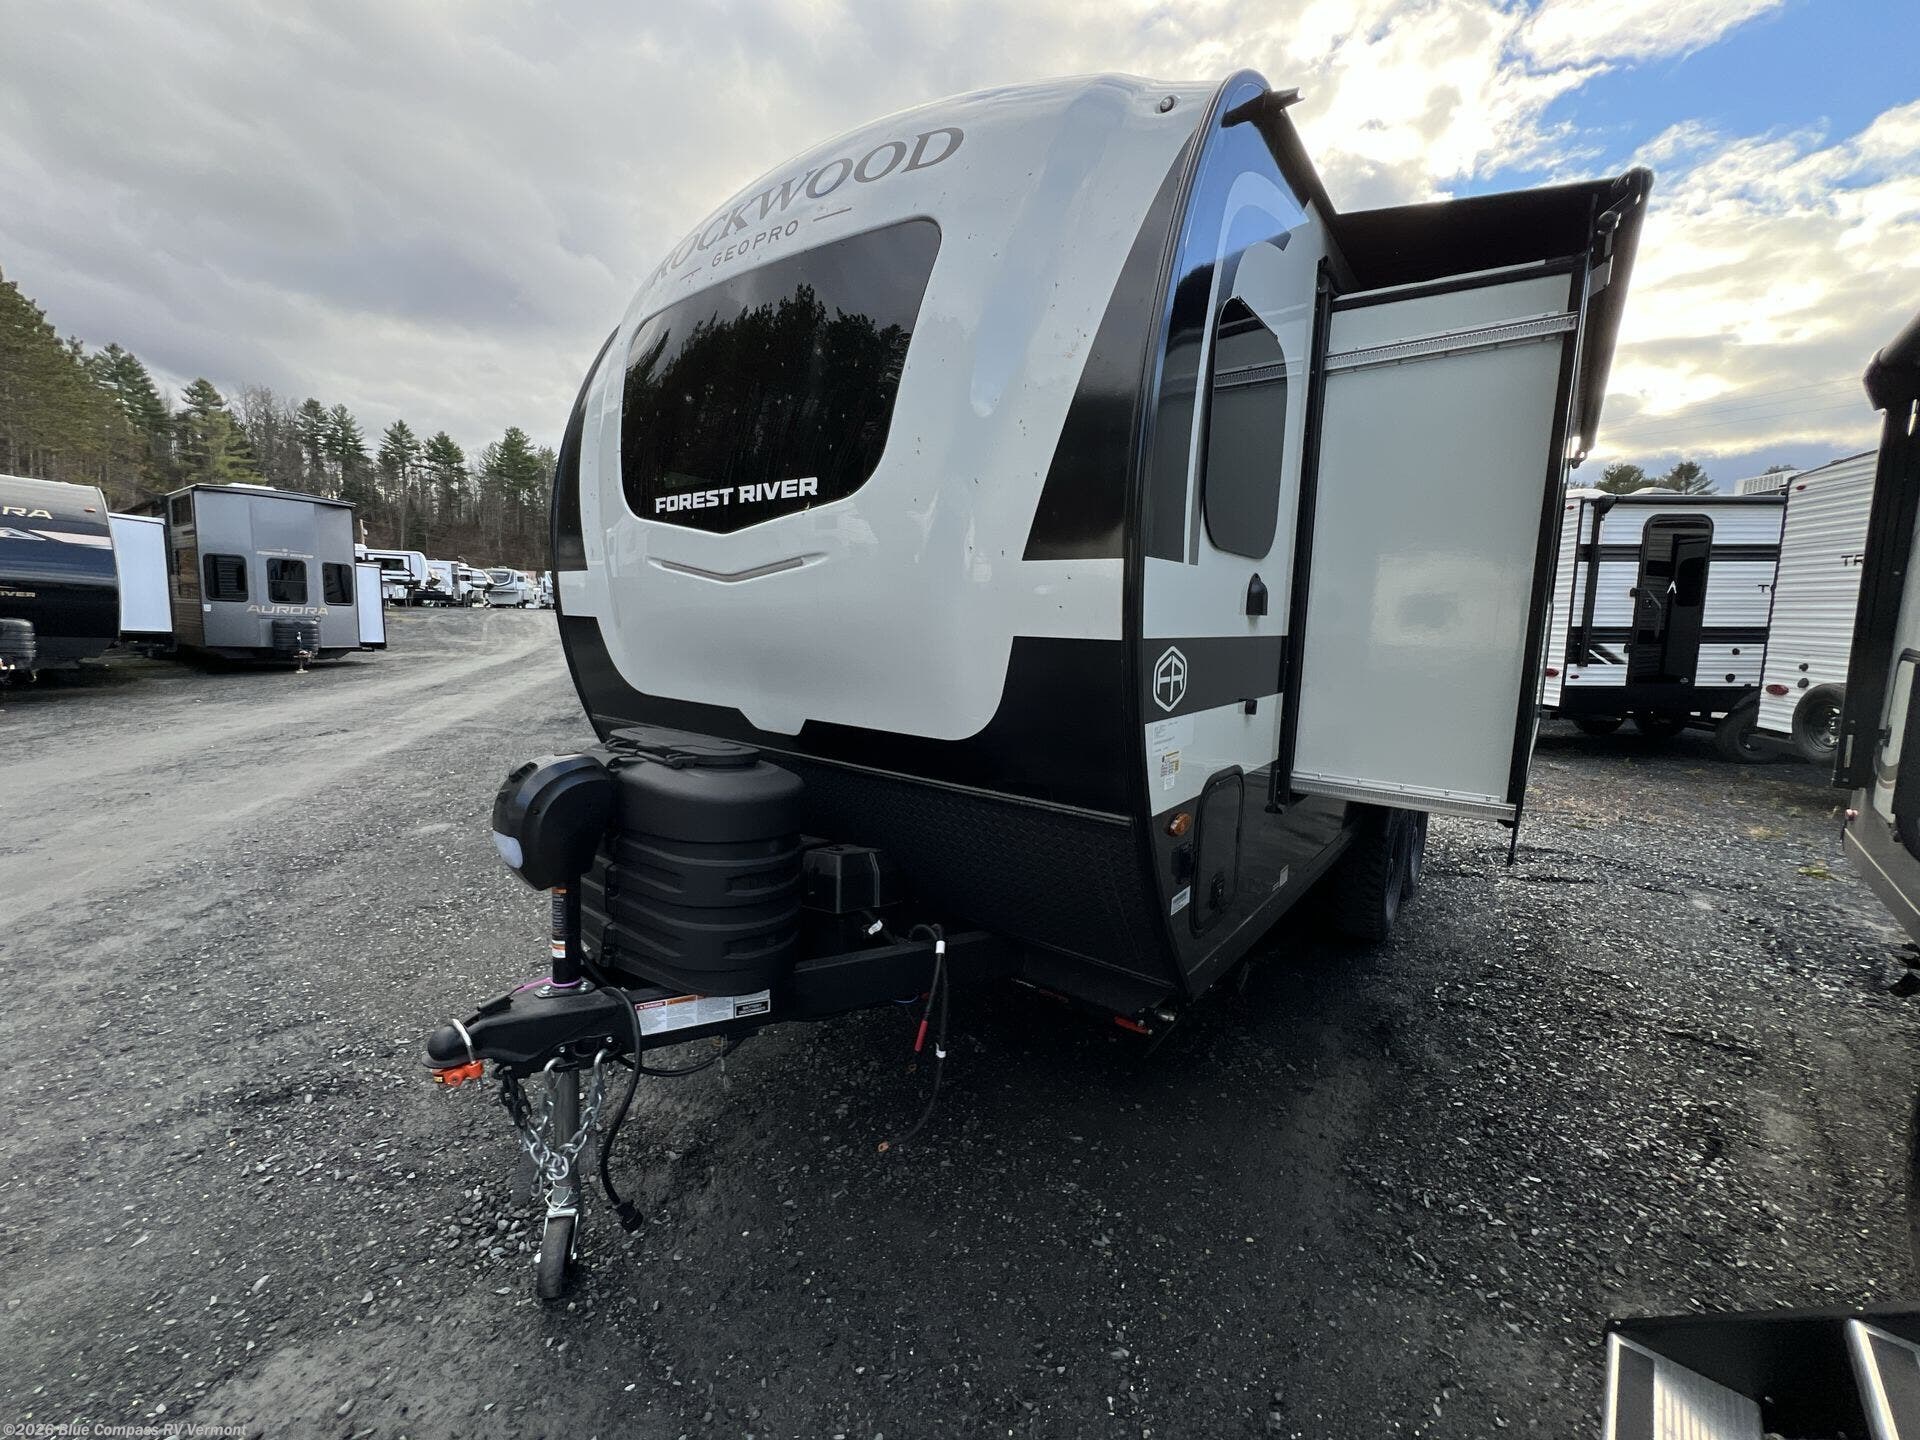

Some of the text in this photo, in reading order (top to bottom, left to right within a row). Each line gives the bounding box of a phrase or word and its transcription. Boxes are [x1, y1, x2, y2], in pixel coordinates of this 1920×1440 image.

[650, 127, 965, 289] ROCKWOOD
[711, 219, 799, 268] GEOPRO
[655, 476, 818, 514] FOREST RIVER
[246, 604, 328, 615] AURORA
